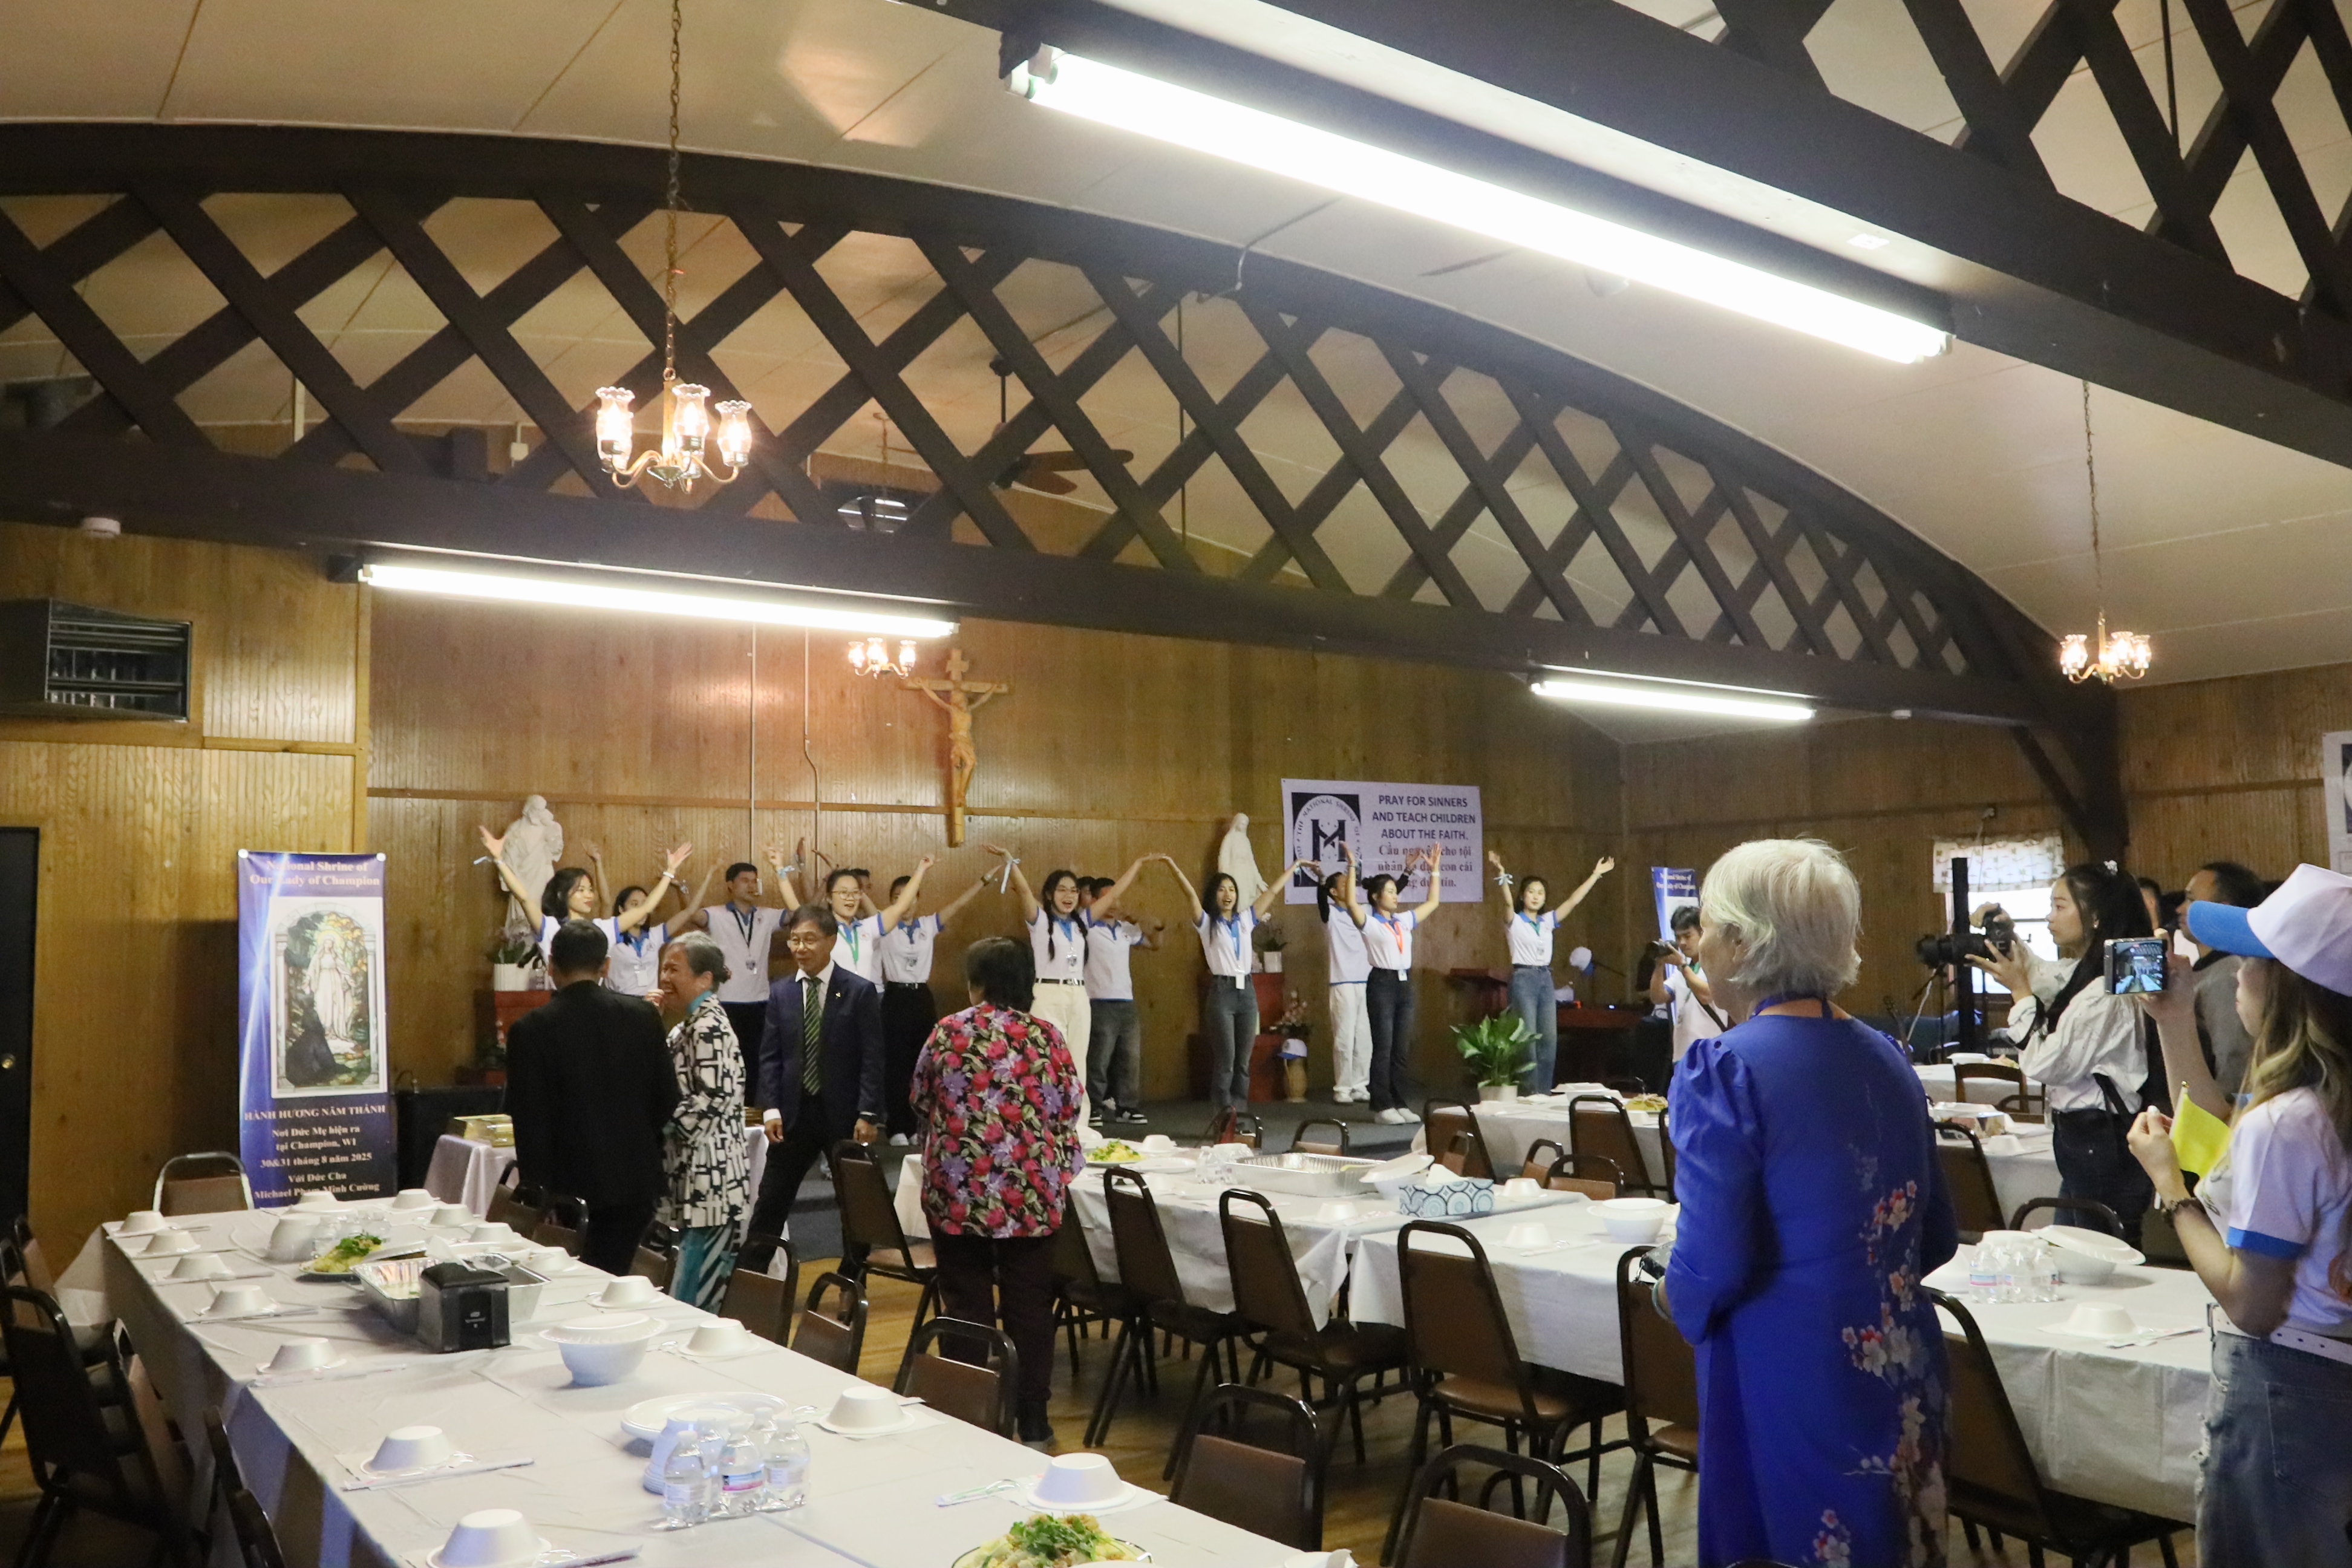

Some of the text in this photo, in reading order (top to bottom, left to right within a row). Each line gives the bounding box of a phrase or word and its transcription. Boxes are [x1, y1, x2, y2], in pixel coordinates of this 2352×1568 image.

[1379, 794, 1468, 807] PRAY FOR SINNERS
[1372, 811, 1475, 824] AND TEACH CHILDREN
[1381, 828, 1469, 840] ABOUT THE FAITH.
[1379, 841, 1399, 855] Cầu
[1441, 846, 1457, 856] cho
[1459, 846, 1471, 859] tội
[317, 861, 354, 872] Shrine
[356, 862, 369, 872] of
[249, 874, 272, 884] Our
[308, 875, 321, 885] of
[322, 875, 381, 887] Champion
[244, 1109, 276, 1120] HÀNH
[279, 1108, 319, 1119] HƯƠNG
[322, 1106, 346, 1116] NĂM
[312, 1126, 327, 1136] Mẹ
[290, 1139, 341, 1150] Champion,
[342, 1137, 357, 1146] WI
[260, 1158, 290, 1168] 30&31
[293, 1156, 320, 1166] tháng
[321, 1155, 328, 1164] 8
[351, 1152, 373, 1161] 2025
[327, 1172, 347, 1180] Cha
[254, 1188, 292, 1199] Michael
